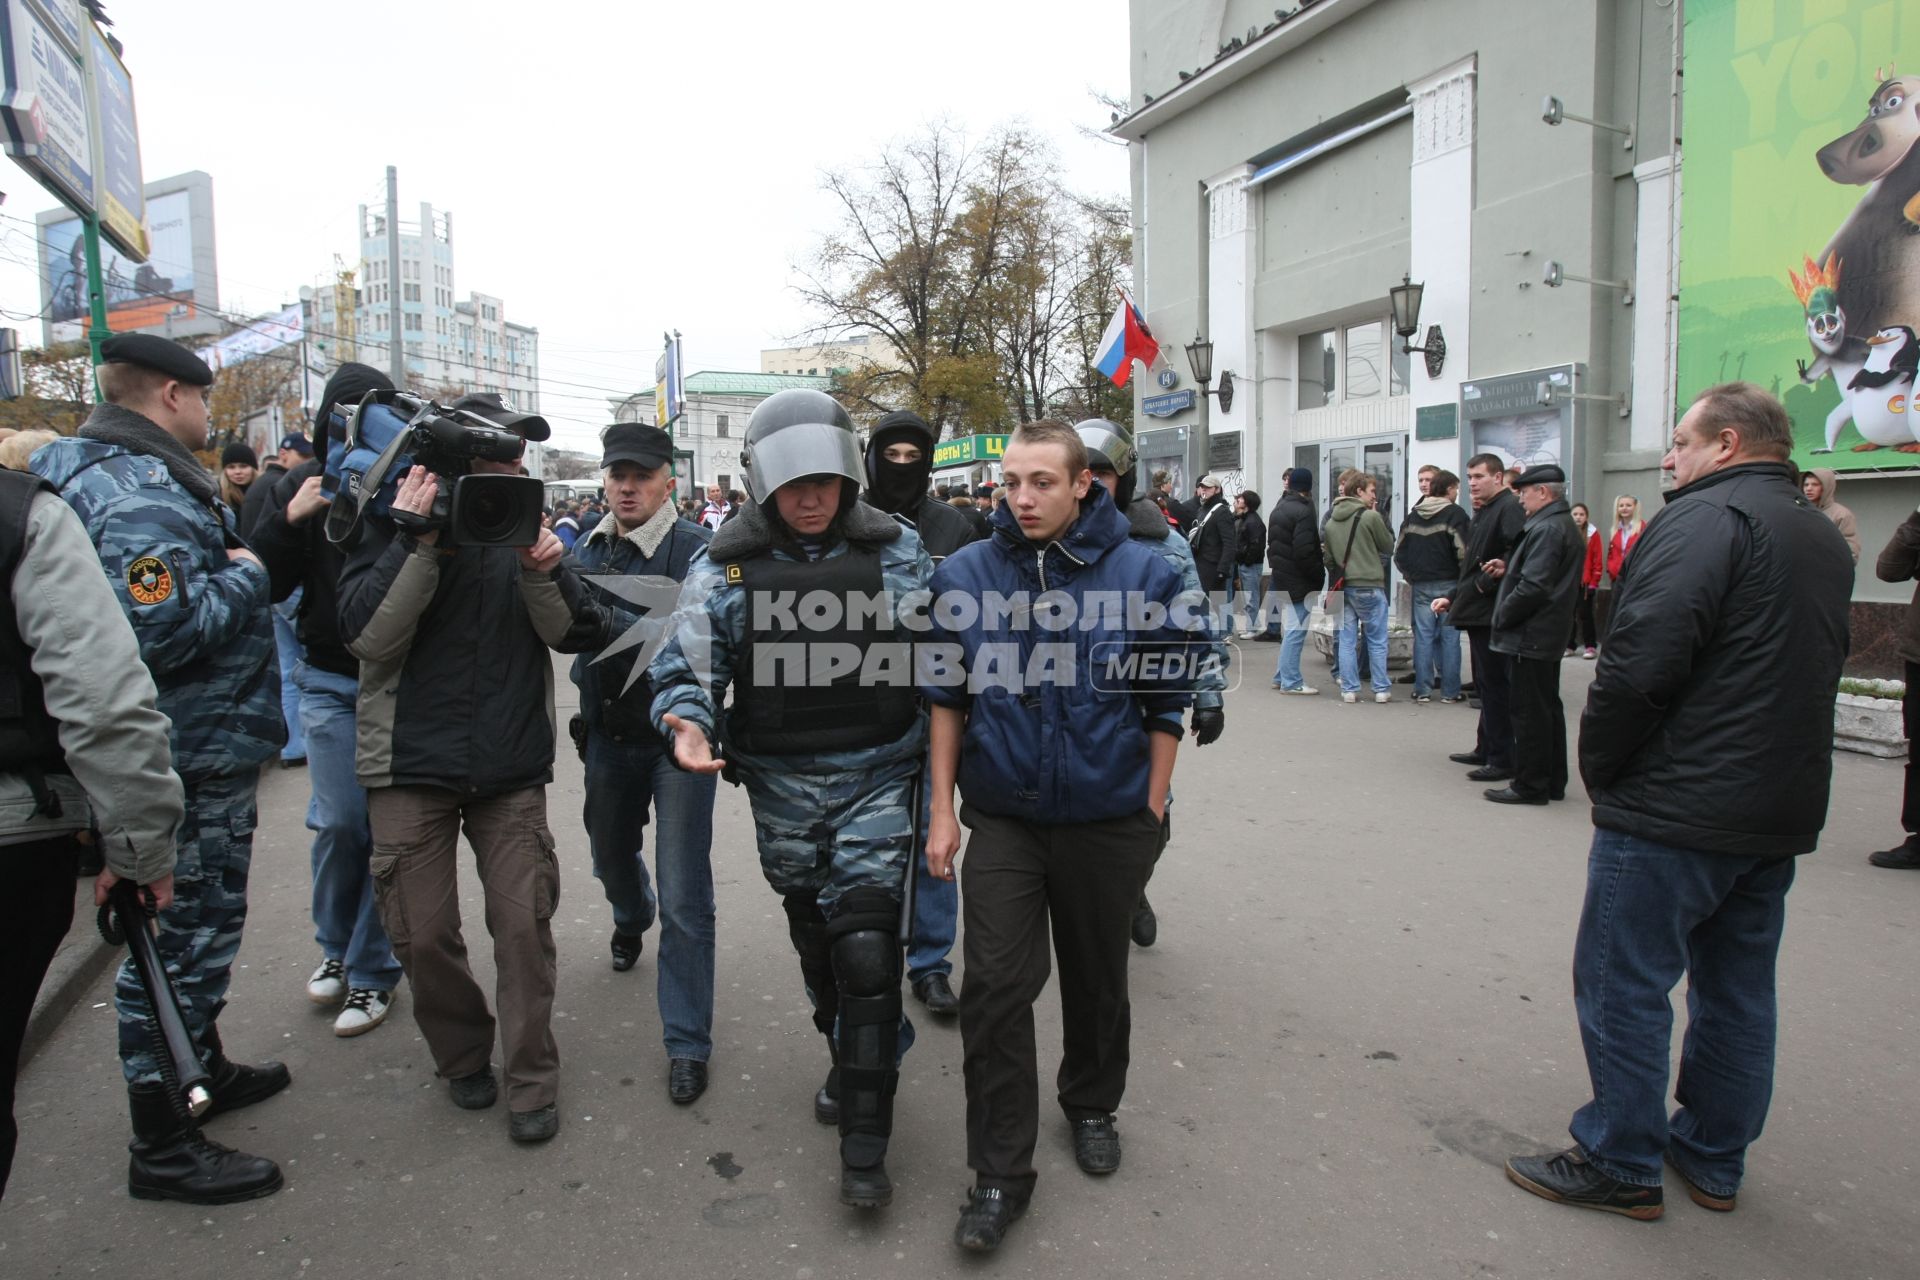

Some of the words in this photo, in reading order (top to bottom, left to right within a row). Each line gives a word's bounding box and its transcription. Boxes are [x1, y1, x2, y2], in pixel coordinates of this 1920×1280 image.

[1162, 372, 1170, 386] 14
[1484, 380, 1537, 397] КИНОТЕАТ
[962, 441, 970, 453] 24
[986, 438, 1004, 458] Ц
